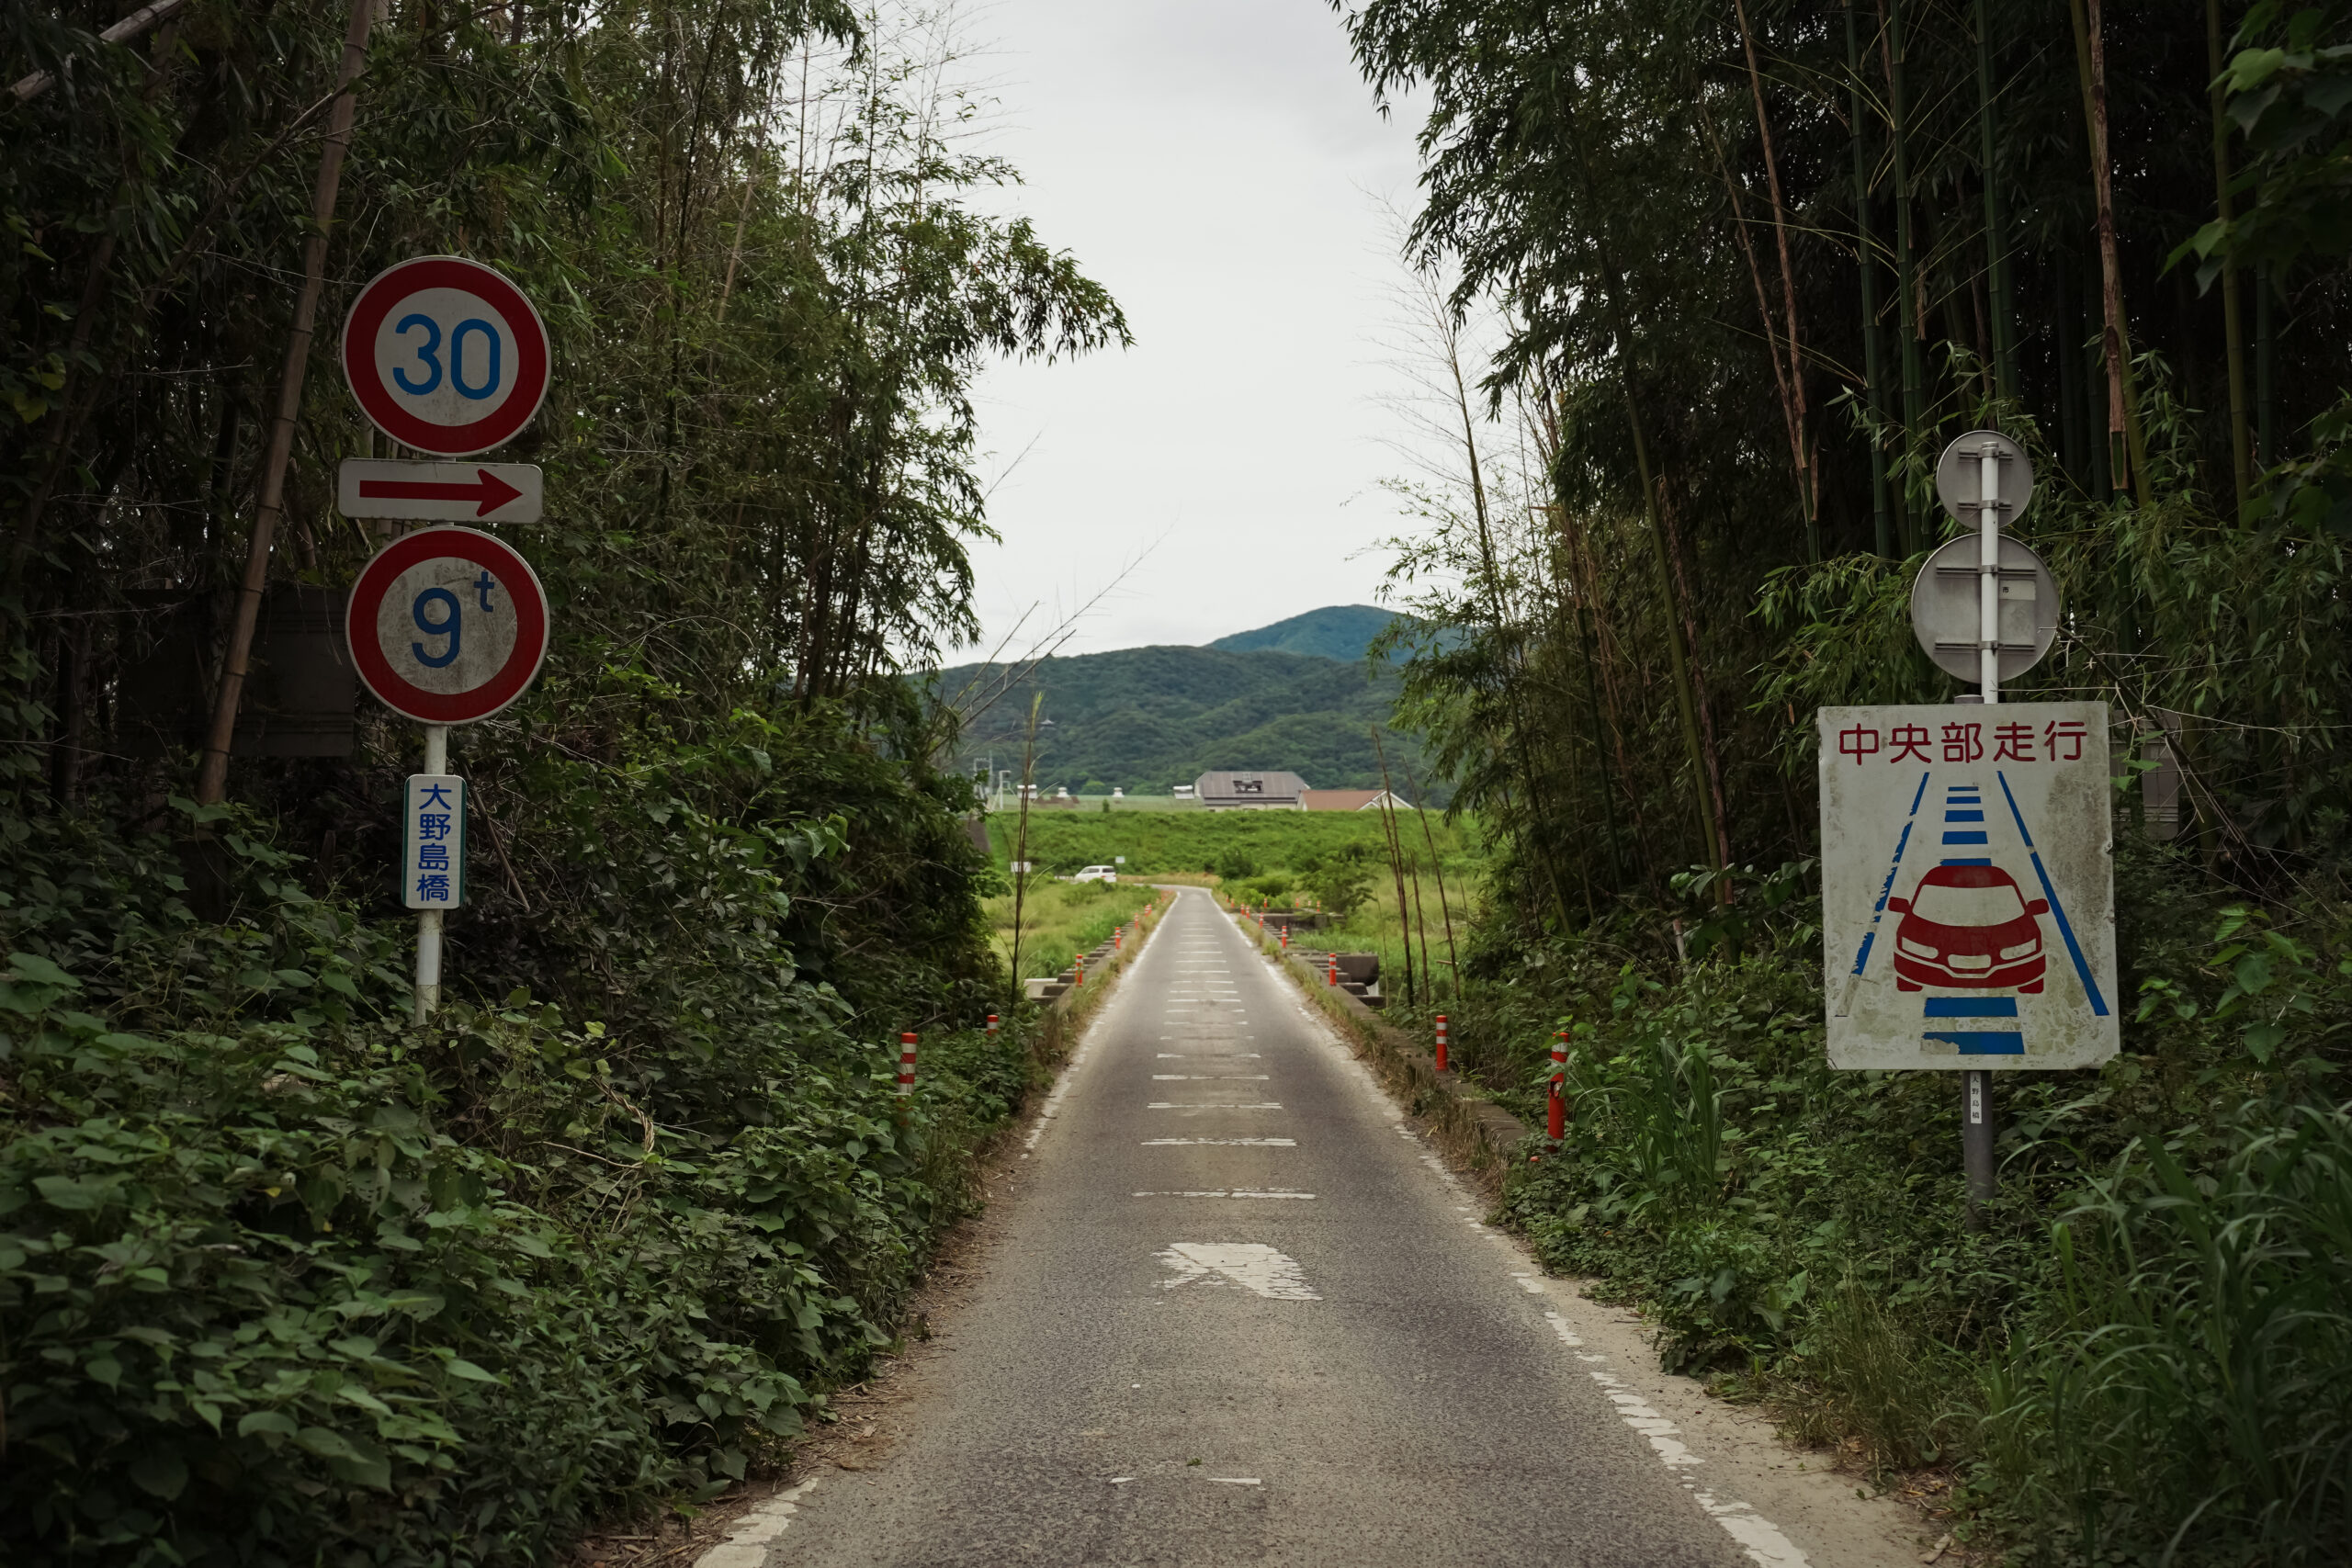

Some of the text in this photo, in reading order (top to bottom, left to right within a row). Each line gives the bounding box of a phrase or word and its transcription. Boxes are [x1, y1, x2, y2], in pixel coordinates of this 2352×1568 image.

[392, 313, 502, 400] 30
[1838, 720, 2088, 766] 中央部走行
[415, 783, 452, 902] 大野島橋
